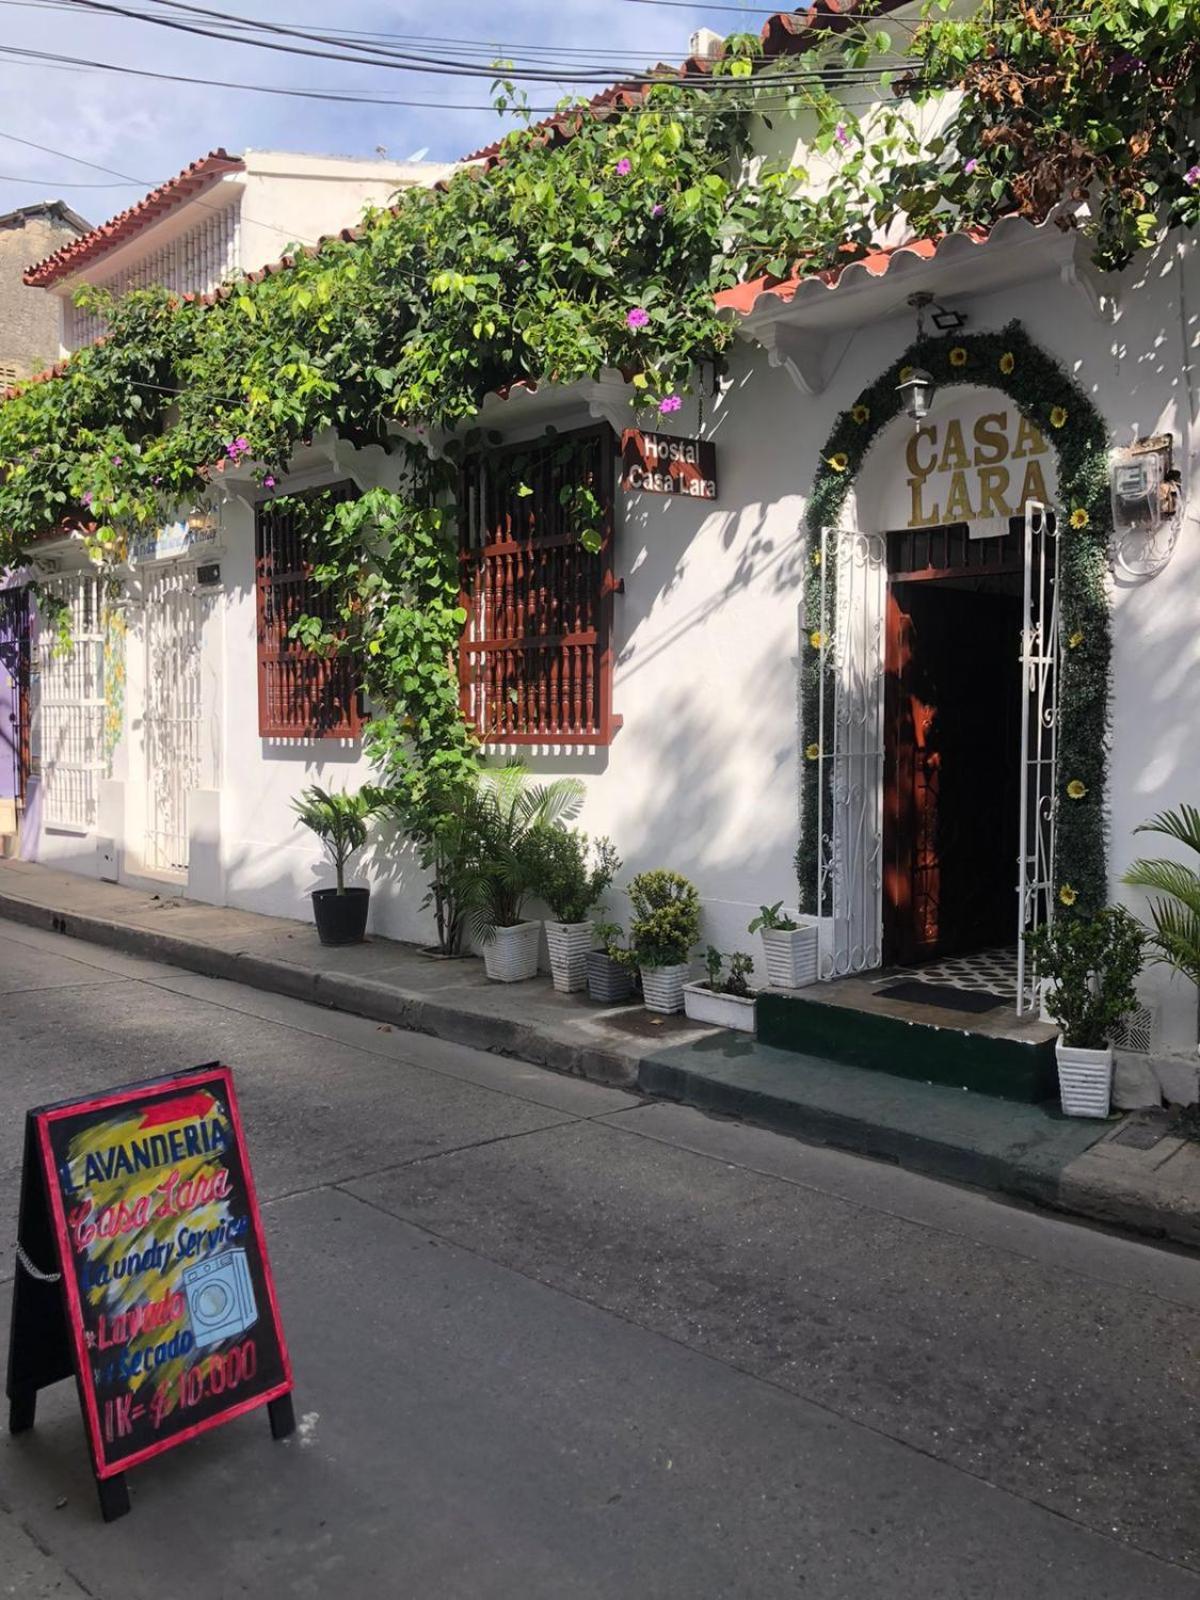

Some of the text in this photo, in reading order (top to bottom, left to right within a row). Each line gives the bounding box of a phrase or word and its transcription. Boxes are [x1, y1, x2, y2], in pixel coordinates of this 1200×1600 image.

[644, 435, 700, 464] Hostal
[905, 410, 1049, 477] CASA
[629, 464, 717, 497] Casa Lara
[907, 459, 1055, 527] LARA
[60, 1117, 228, 1195] LAVANDERIA
[69, 1168, 233, 1253] Casa Lara
[81, 1215, 249, 1290] Laundry Service
[98, 1287, 186, 1350] Lavado
